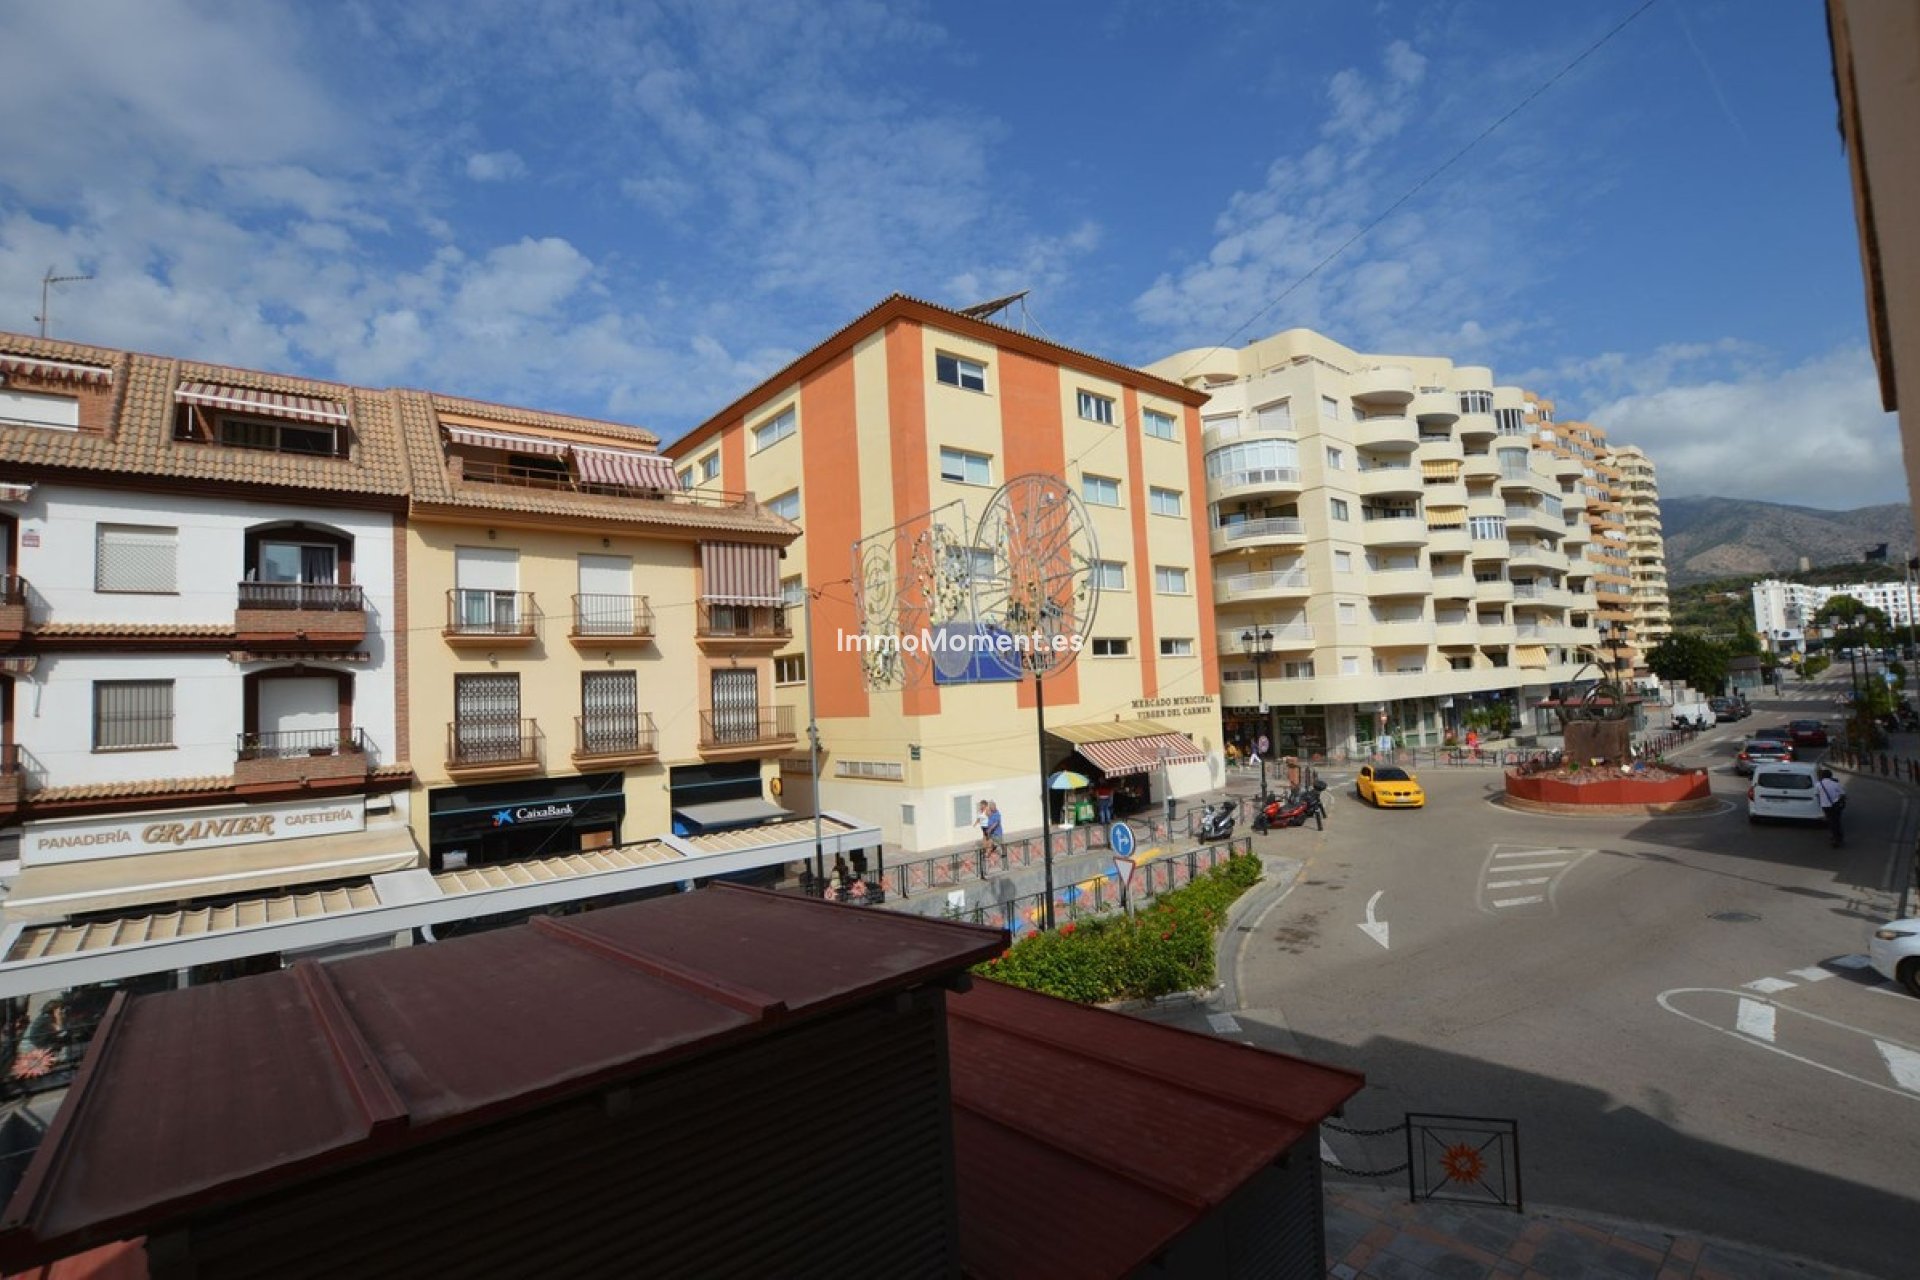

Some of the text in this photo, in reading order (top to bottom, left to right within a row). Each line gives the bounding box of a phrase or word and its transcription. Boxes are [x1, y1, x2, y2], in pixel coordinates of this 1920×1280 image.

[1131, 699, 1171, 708] MERCADO
[516, 804, 573, 820] CaixaBank
[37, 808, 352, 850] PANADERÍA GRANIER CAFETERÍA
